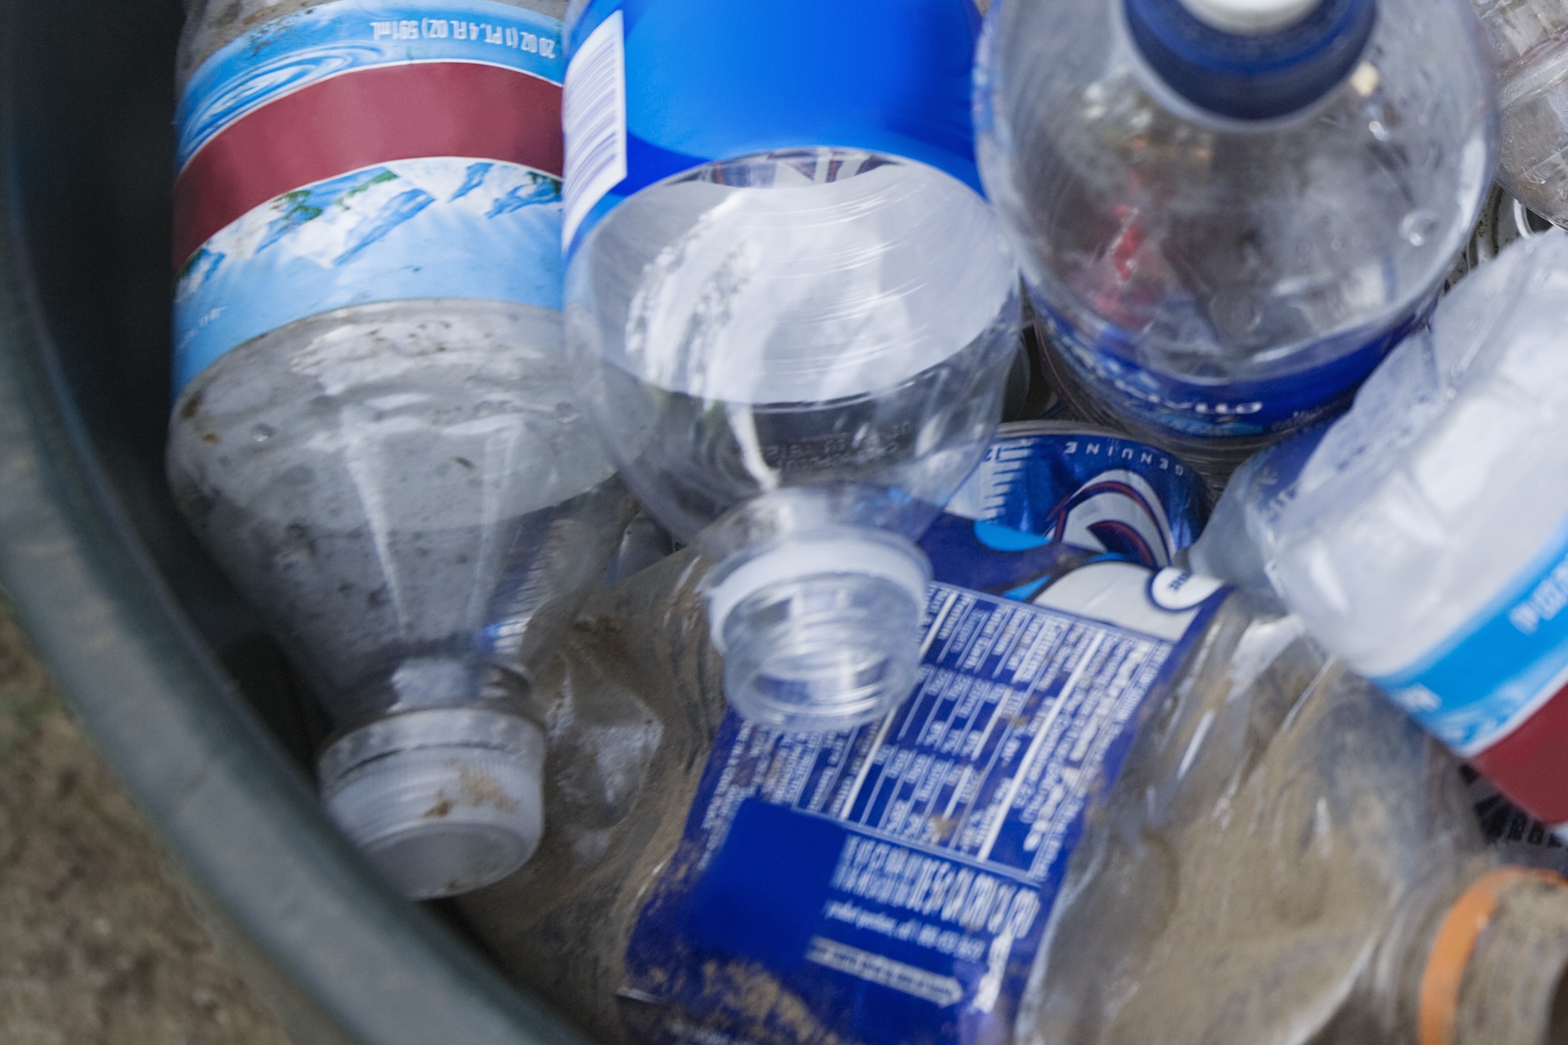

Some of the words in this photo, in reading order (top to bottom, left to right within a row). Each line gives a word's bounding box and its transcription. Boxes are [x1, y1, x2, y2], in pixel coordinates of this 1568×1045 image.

[421, 17, 448, 39] OZ)
[449, 20, 467, 40] FL
[505, 27, 519, 49] (1
[519, 31, 537, 53] OZ
[538, 37, 556, 59] 20
[1064, 441, 1185, 477] GENUINE
[988, 606, 1029, 657] Sodium
[1019, 764, 1079, 854] Facts
